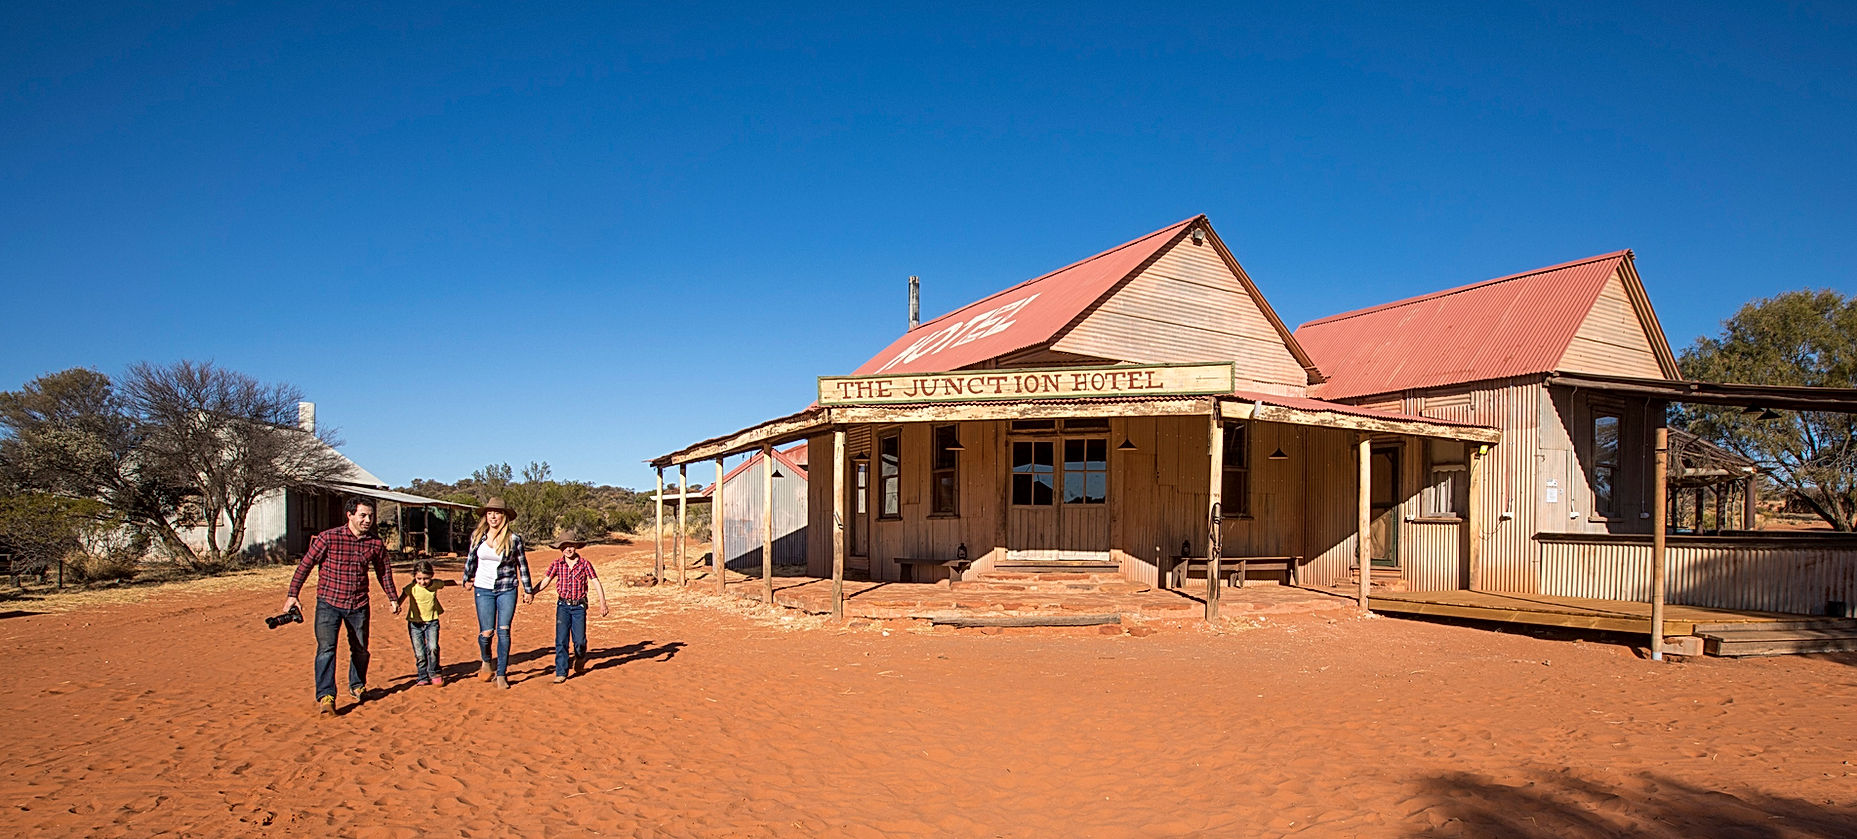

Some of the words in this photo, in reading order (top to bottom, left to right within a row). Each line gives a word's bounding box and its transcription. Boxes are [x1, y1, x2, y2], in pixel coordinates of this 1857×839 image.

[874, 292, 1041, 374] HOTEL
[837, 380, 893, 399] THE
[904, 372, 1060, 396] JUNCTION
[1072, 370, 1164, 391] HOTEL
